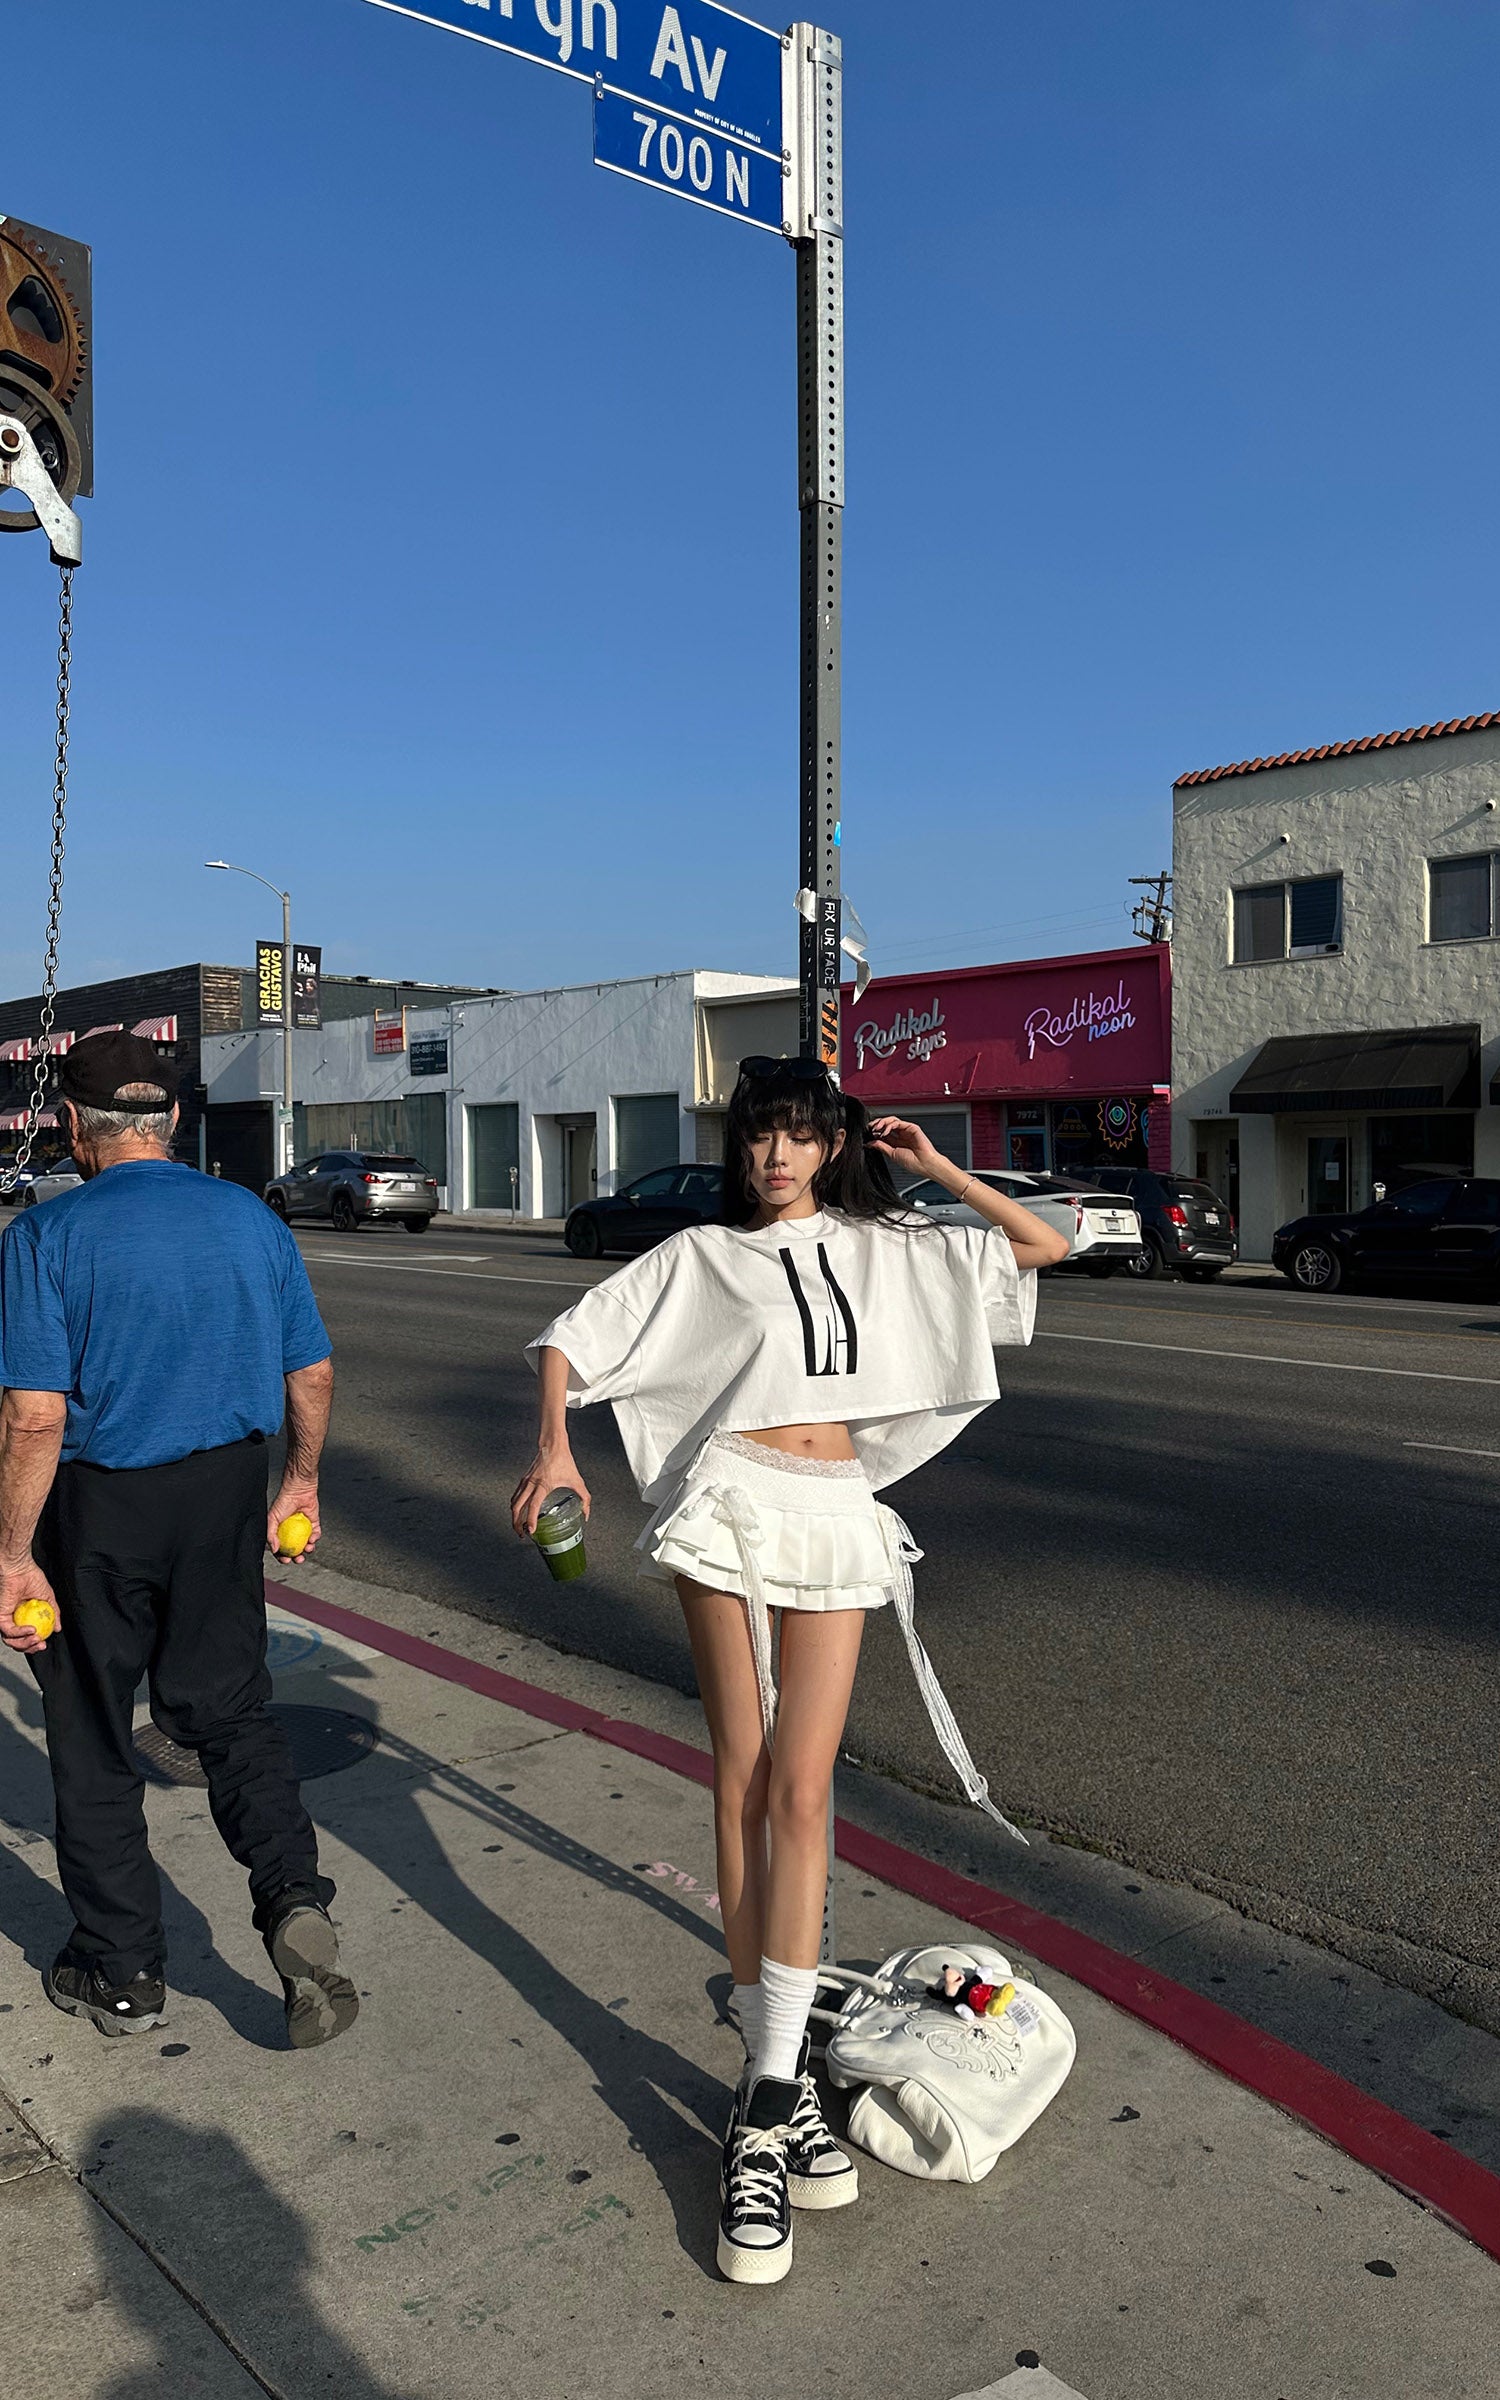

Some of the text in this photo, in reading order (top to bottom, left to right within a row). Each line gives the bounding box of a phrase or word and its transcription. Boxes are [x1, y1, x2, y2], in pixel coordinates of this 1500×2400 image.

[650, 5, 727, 102] Av
[633, 111, 749, 208] 700 N
[297, 952, 310, 963] LA
[297, 962, 317, 973] Phil
[824, 902, 836, 985] FIX UR FACE
[259, 948, 271, 1010] GRACIAS
[270, 949, 283, 1011] GUSTAVO
[853, 998, 946, 1070] Radikal
[906, 1030, 948, 1062] signs
[1023, 979, 1131, 1060] Radikal
[1088, 1012, 1137, 1042] neon
[1016, 1110, 1038, 1120] 7972
